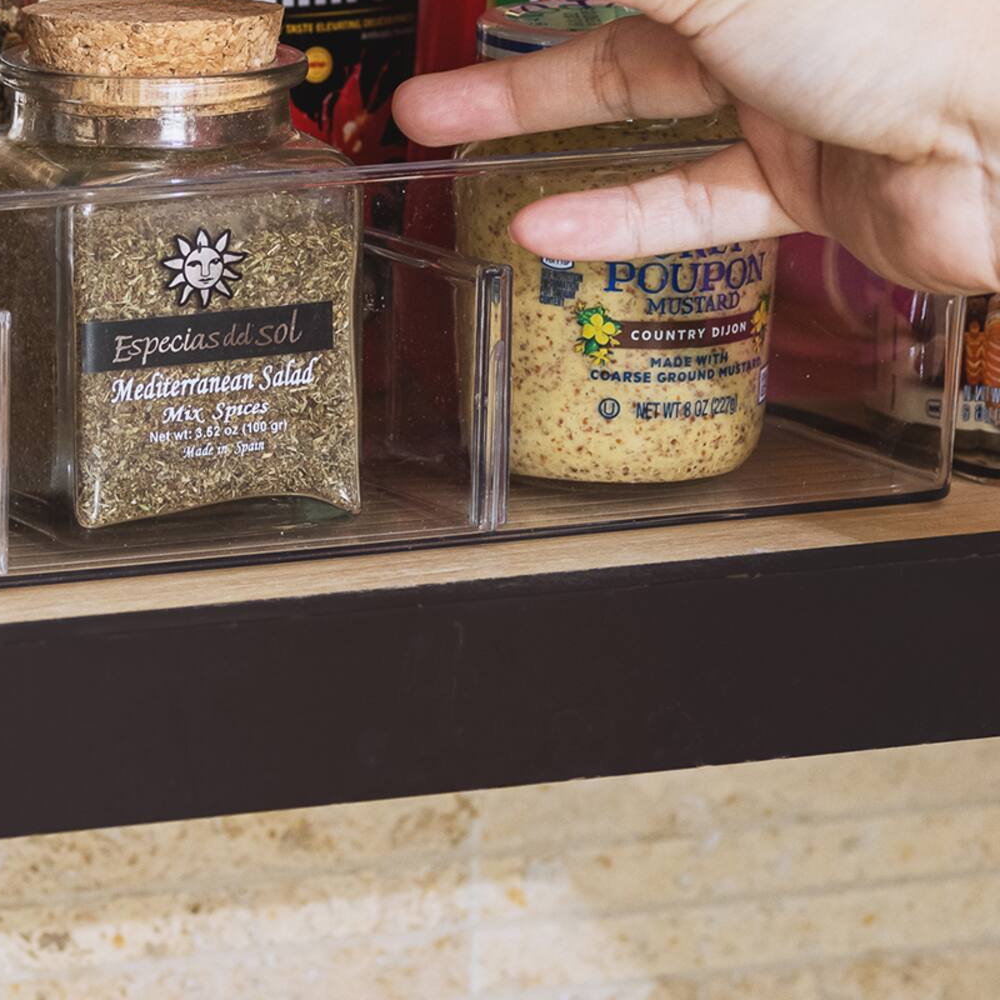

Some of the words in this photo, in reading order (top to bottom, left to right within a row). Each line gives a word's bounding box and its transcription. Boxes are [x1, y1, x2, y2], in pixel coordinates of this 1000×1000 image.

[603, 252, 767, 295] POUPON
[646, 290, 740, 316] MUSTARD
[111, 327, 220, 366] Especias
[255, 308, 303, 347] sol
[630, 327, 706, 341] COUNTRY
[711, 321, 747, 338] DIJON
[590, 369, 652, 383] COARSE
[657, 367, 715, 384] GROUND
[718, 356, 762, 378] MUSTARD
[650, 355, 692, 369] MADE
[695, 351, 729, 366] WITH
[111, 371, 254, 404] Mediterranean
[259, 356, 319, 391] Salad
[162, 404, 206, 424] Mix
[211, 401, 270, 424] Spices
[635, 401, 661, 420] NET
[662, 401, 682, 419] WT
[683, 400, 692, 419] 8
[694, 399, 709, 418] OZ
[711, 393, 738, 417] (227g)
[149, 430, 171, 443] Net
[173, 428, 192, 441] wt:
[224, 426, 239, 437] oz
[242, 420, 268, 437] (100
[270, 419, 288, 434] gr)
[183, 442, 214, 459] Made
[217, 443, 229, 455] in
[234, 440, 265, 457] Spain
